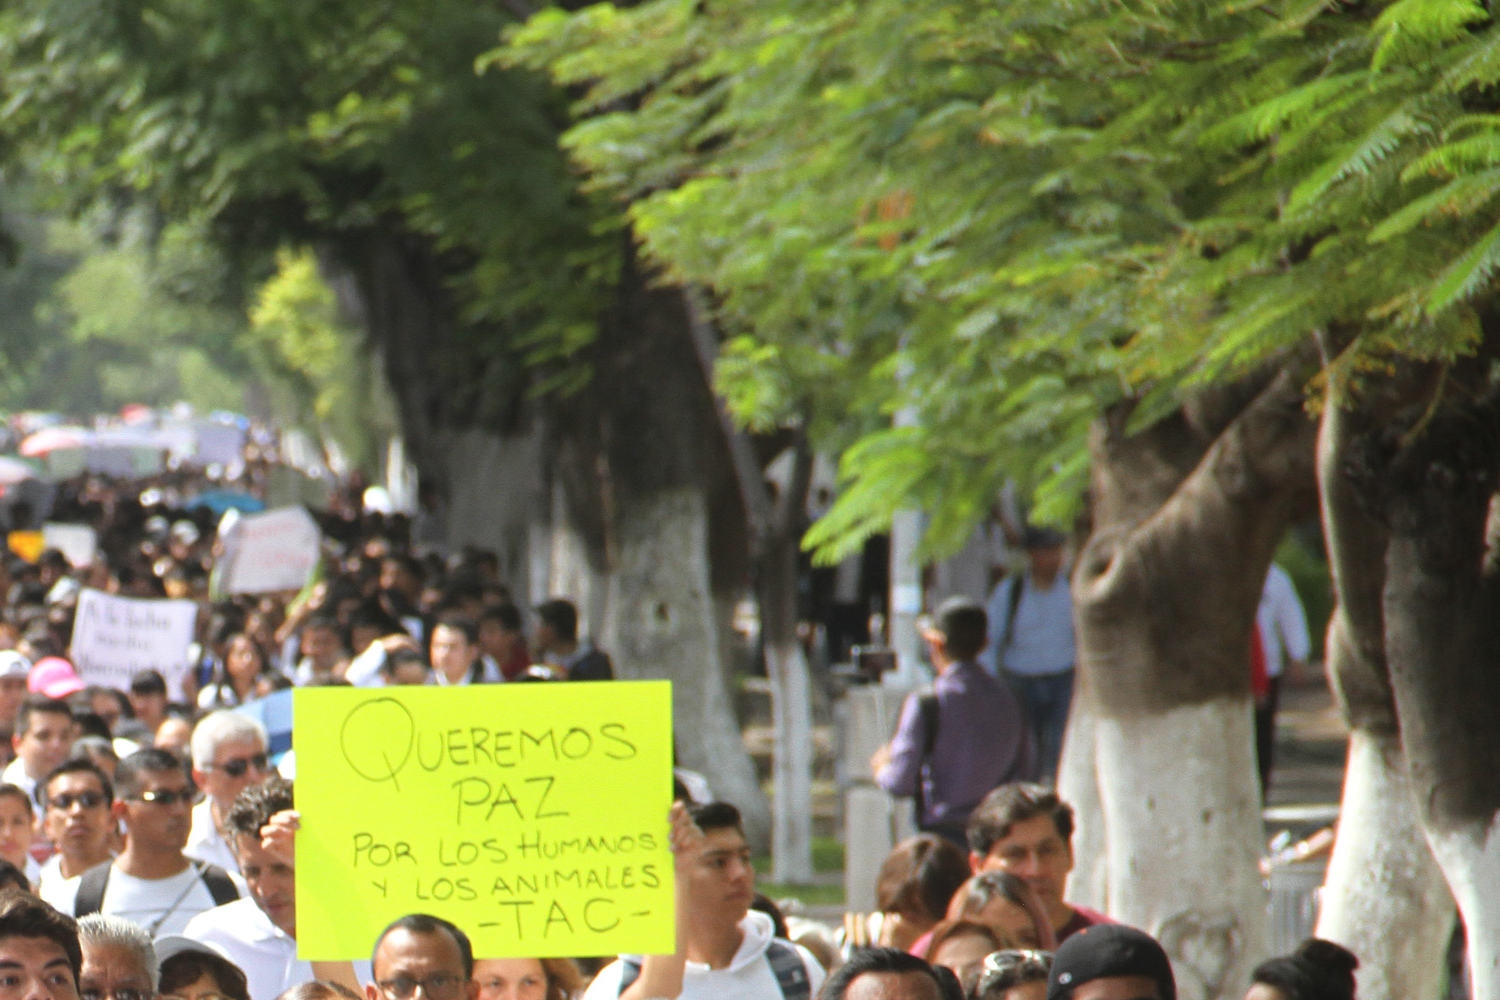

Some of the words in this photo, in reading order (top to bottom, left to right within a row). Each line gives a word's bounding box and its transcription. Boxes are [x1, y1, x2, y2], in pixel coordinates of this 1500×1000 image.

[339, 696, 638, 793] QUEREMOS
[451, 775, 570, 826] PAZ
[353, 832, 418, 868] POR
[438, 837, 509, 867] LOS
[516, 831, 659, 860] HUMANOS
[371, 879, 388, 898] Y
[415, 876, 479, 901] LOS
[490, 864, 661, 896] ANIMALES
